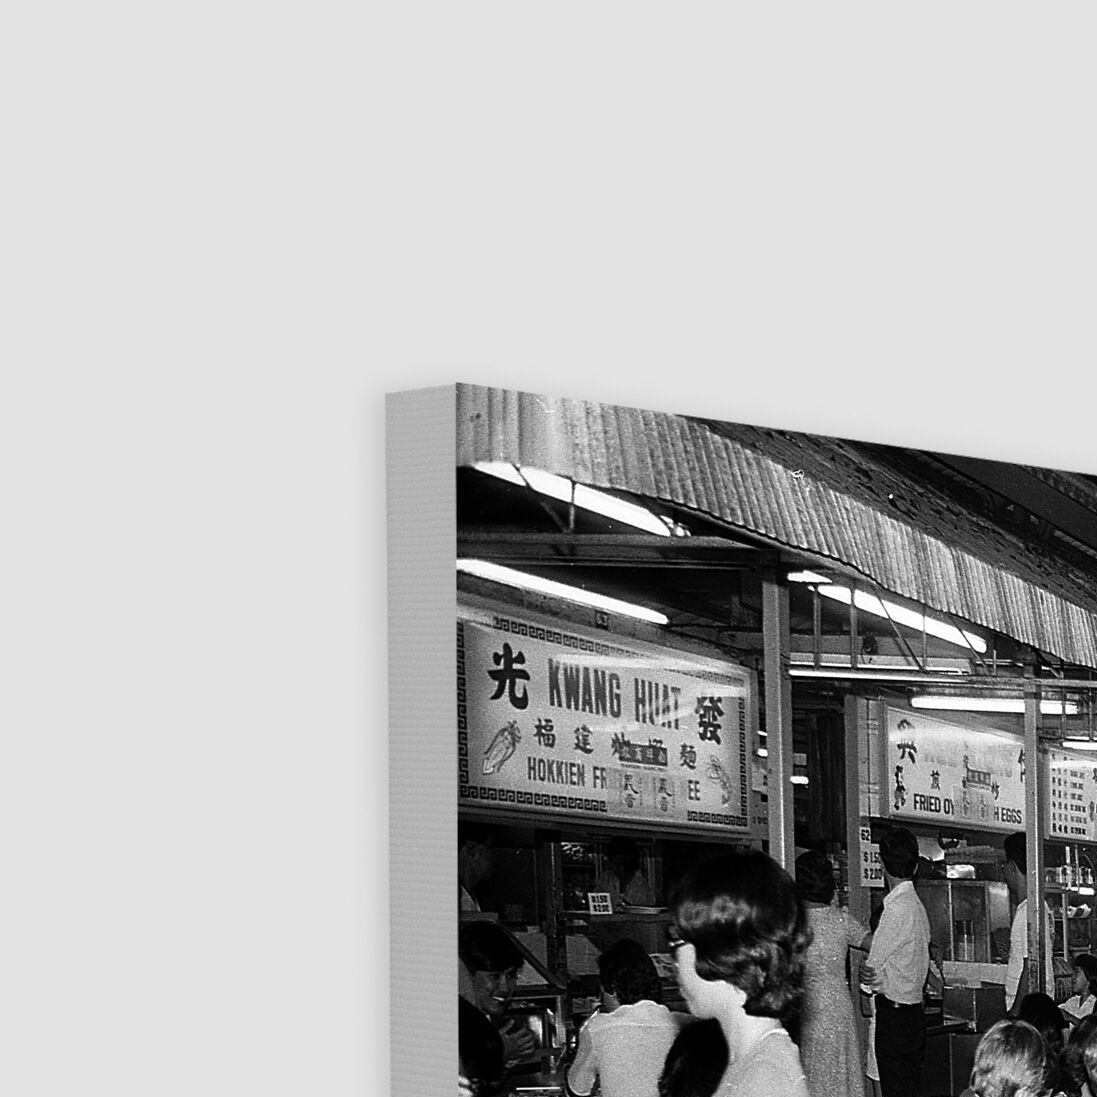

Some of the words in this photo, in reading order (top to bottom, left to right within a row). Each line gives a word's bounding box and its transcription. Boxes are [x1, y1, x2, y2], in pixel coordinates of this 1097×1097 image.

[487, 642, 531, 710] 光
[548, 657, 621, 718] KWANG
[634, 677, 681, 729] HUAT
[527, 756, 586, 787] HOKKIEN
[914, 793, 941, 813] FRIED
[1001, 807, 1022, 824] EGGS
